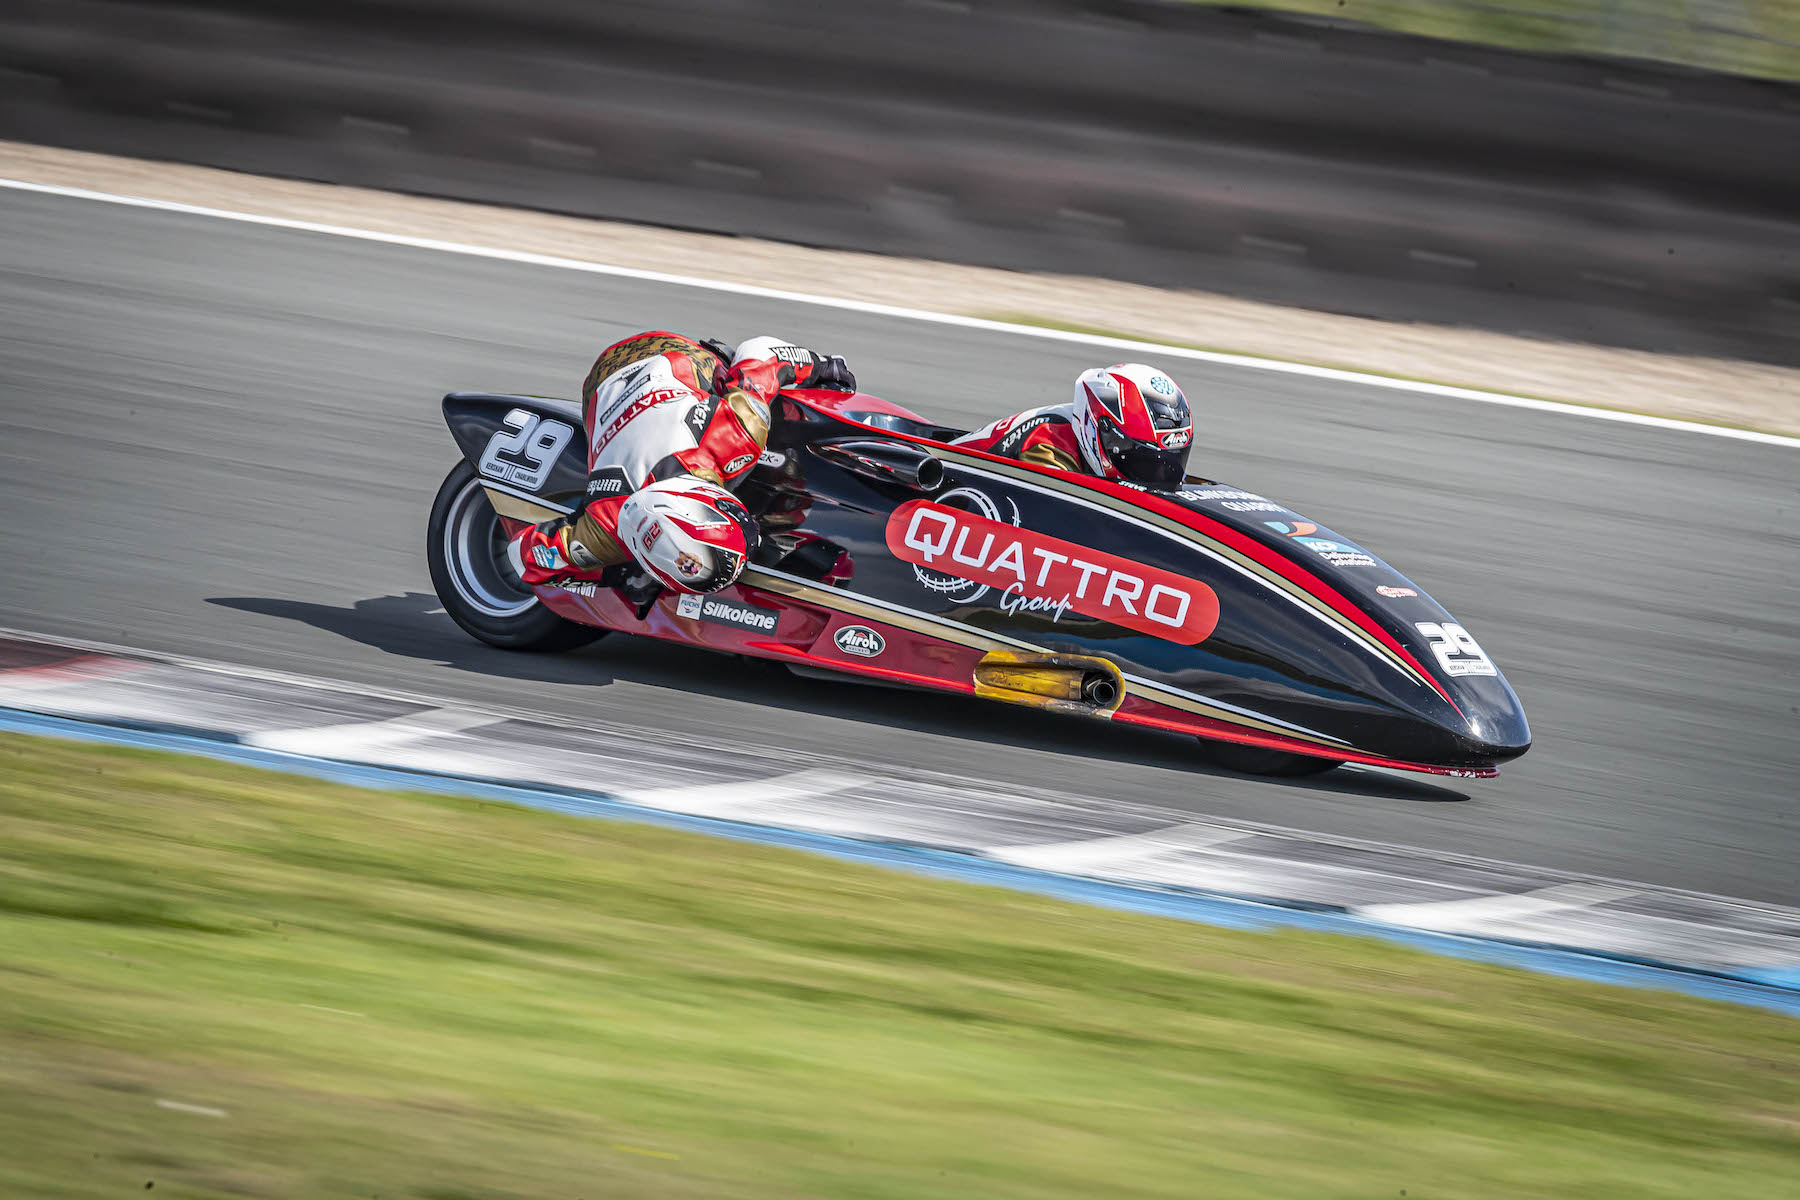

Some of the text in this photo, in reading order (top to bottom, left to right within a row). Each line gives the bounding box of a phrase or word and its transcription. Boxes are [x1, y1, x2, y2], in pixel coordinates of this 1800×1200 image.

[479, 408, 574, 491] 29
[904, 507, 1191, 628] QUATTRO
[702, 601, 775, 630] Silkolene
[1000, 581, 1073, 623] Group
[839, 630, 879, 651] Airoh
[1415, 622, 1497, 677] 29
